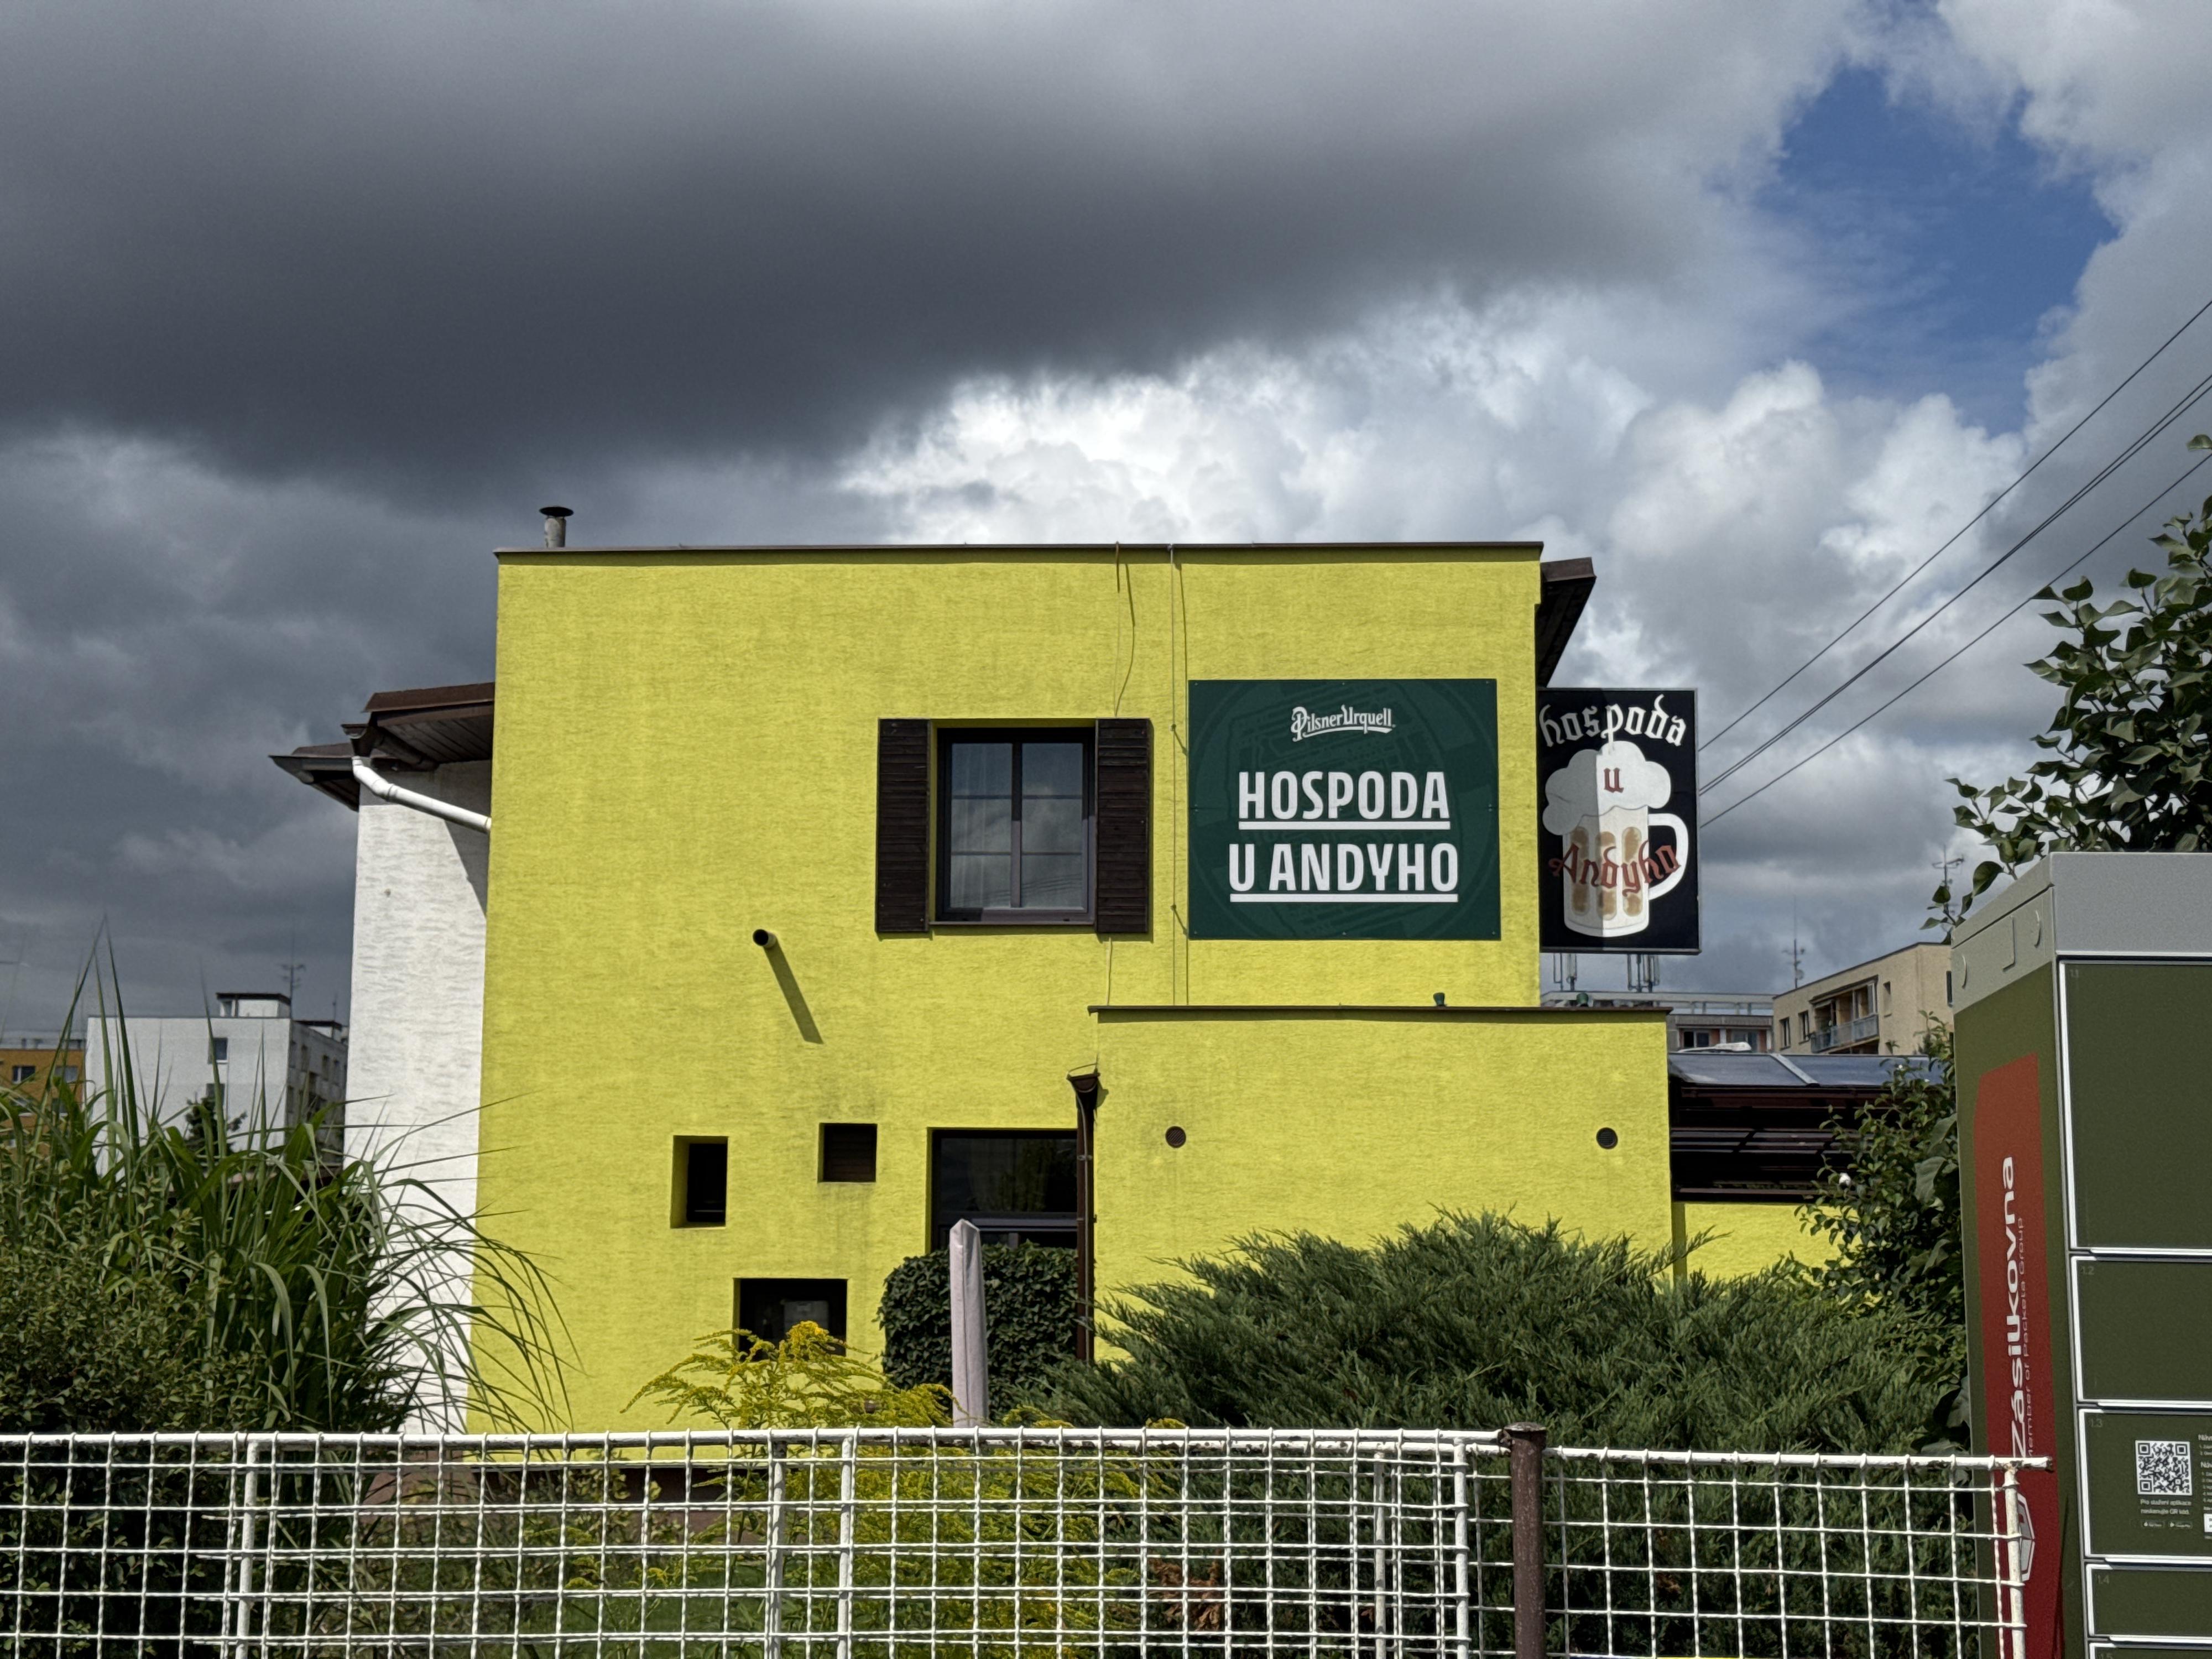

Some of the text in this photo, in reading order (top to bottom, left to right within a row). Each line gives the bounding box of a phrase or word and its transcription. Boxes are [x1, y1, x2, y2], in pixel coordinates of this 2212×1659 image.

[1291, 704, 1392, 742] Pilsner Urquell
[1539, 694, 1686, 753] hospoda
[1239, 771, 1449, 820] HOSPODA
[1604, 767, 1624, 793] u
[1229, 843, 1458, 892] U ANDYHO
[1548, 840, 1681, 897] Andyho
[2002, 1156, 2026, 1458] Zásilkovna
